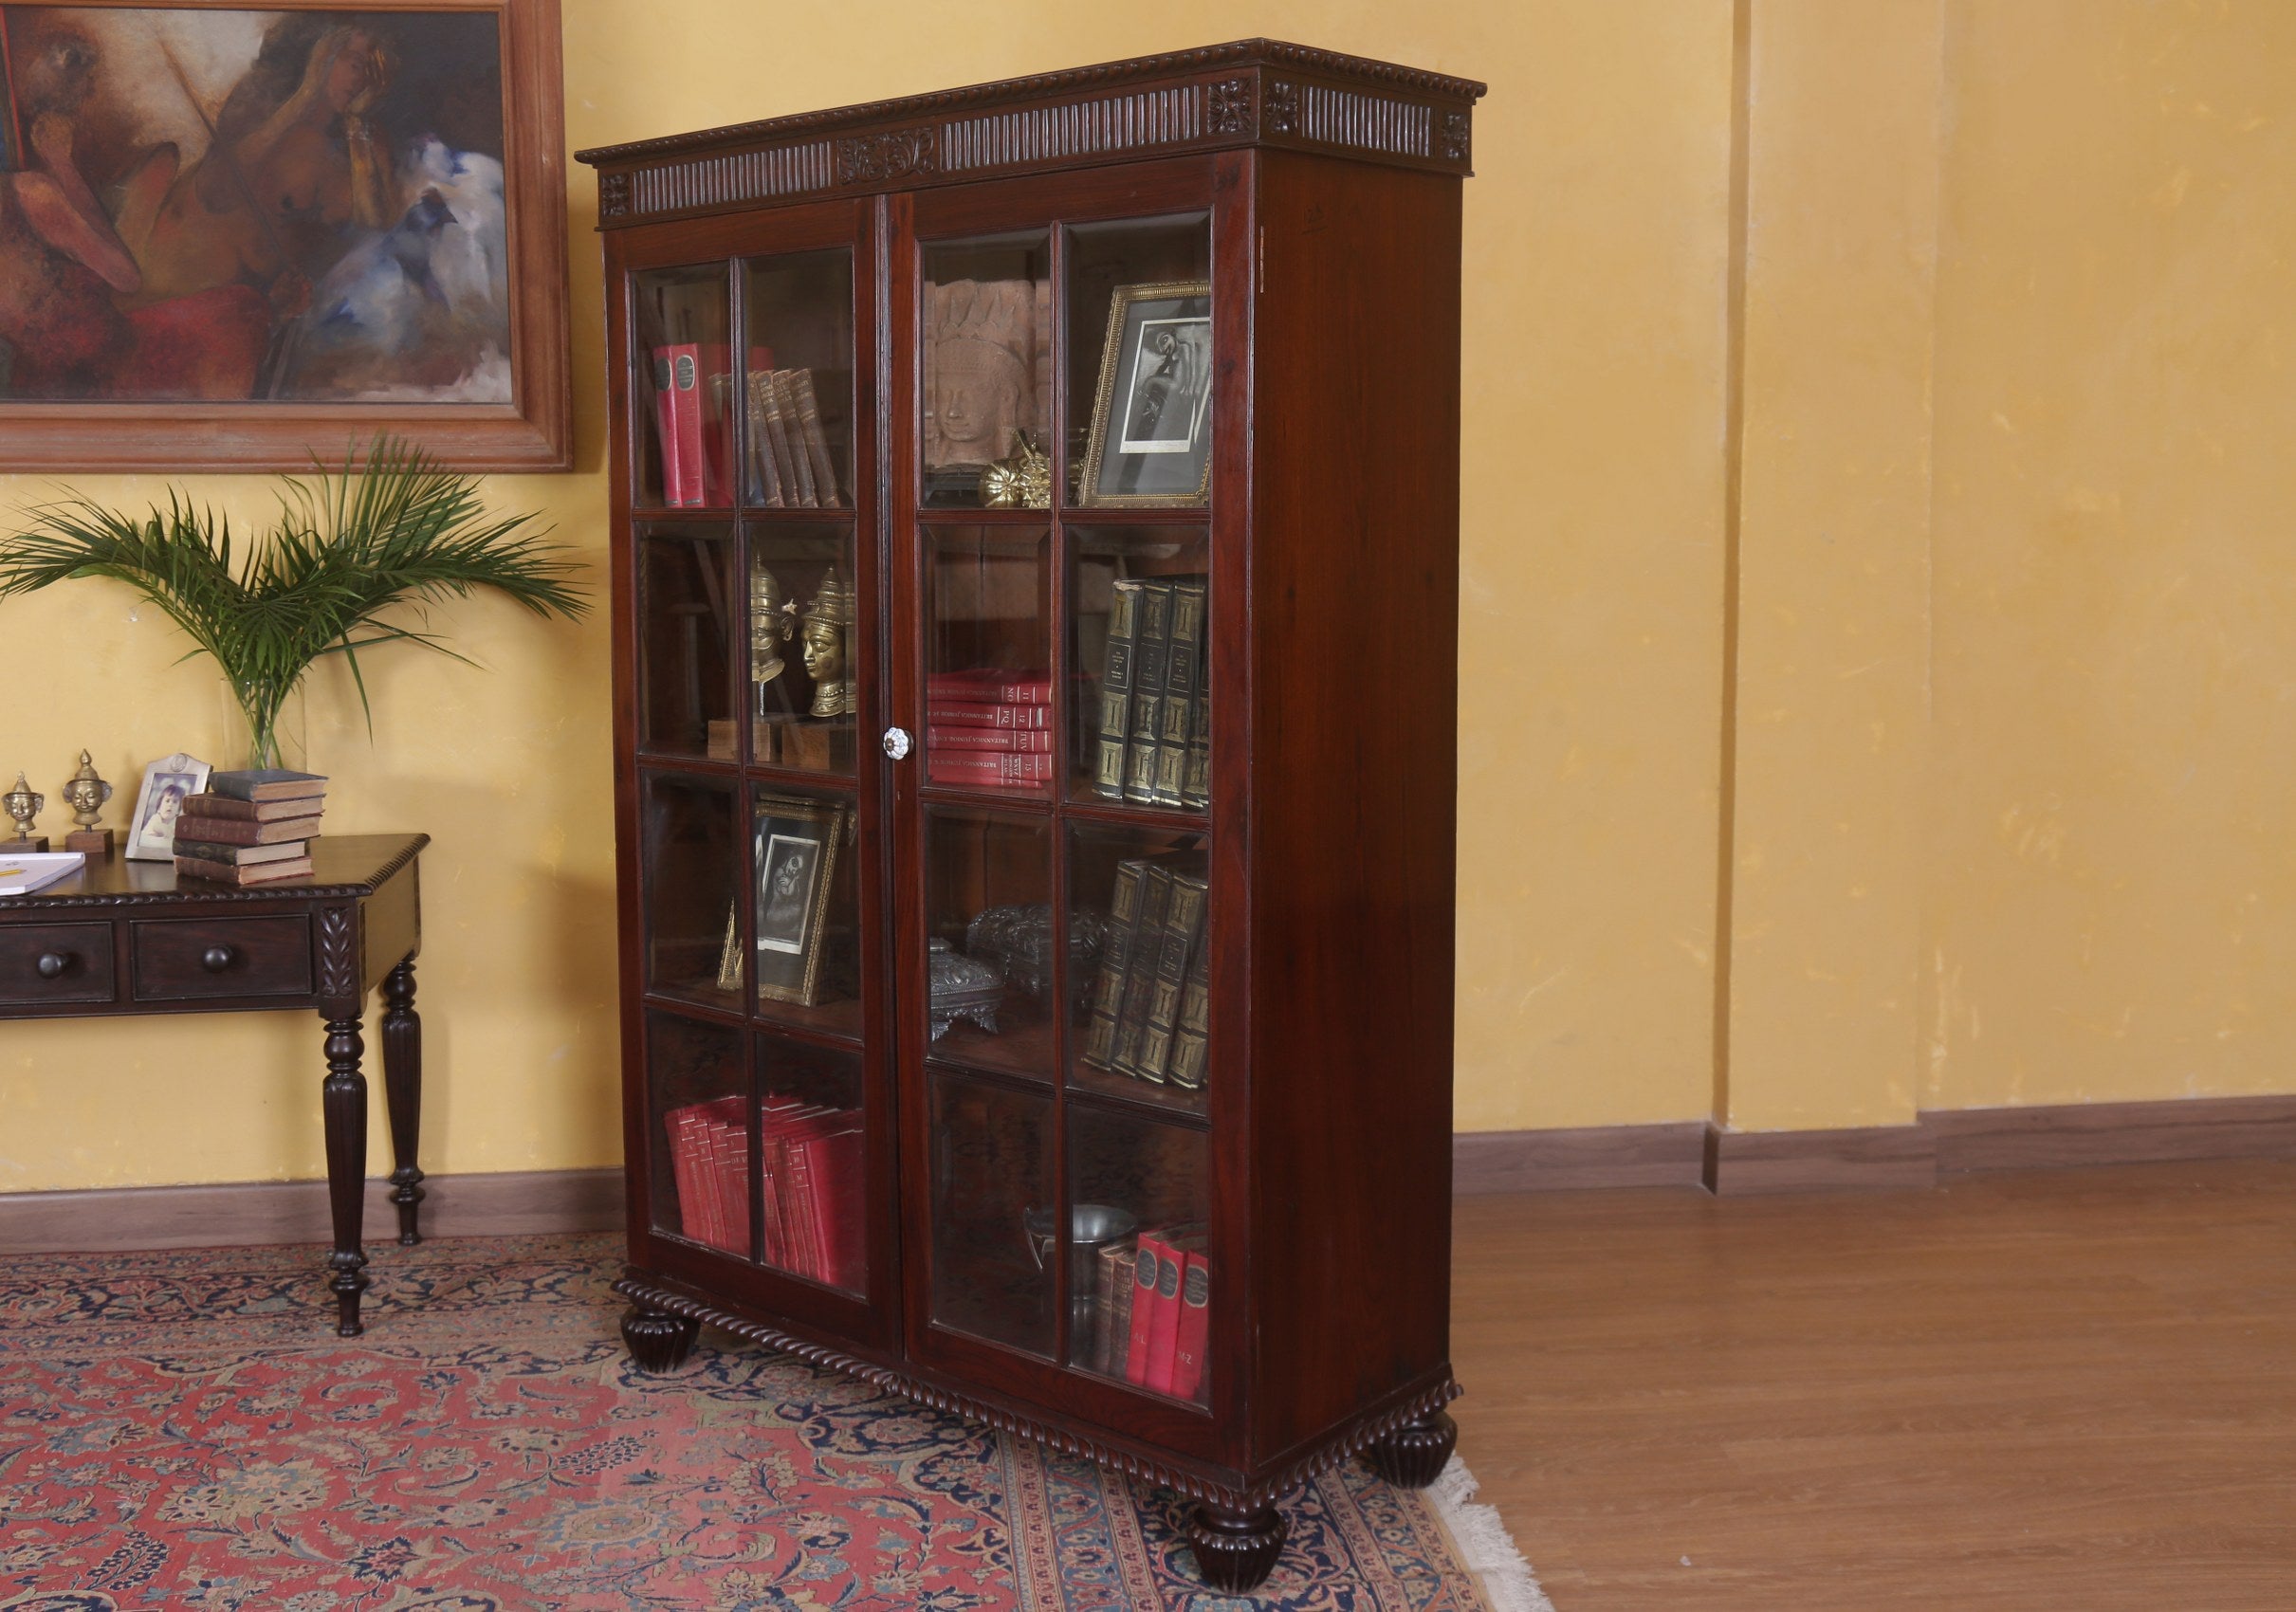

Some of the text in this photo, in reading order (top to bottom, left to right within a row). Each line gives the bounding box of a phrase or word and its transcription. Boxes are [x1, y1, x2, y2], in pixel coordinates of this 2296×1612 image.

[1007, 687, 1015, 702] NO
[1001, 710, 1010, 724] PQ
[1019, 715, 1025, 724] 12
[972, 736, 1009, 744] BRITANNICA
[963, 760, 997, 768] BRITANNICA
[1025, 763, 1031, 772] 15
